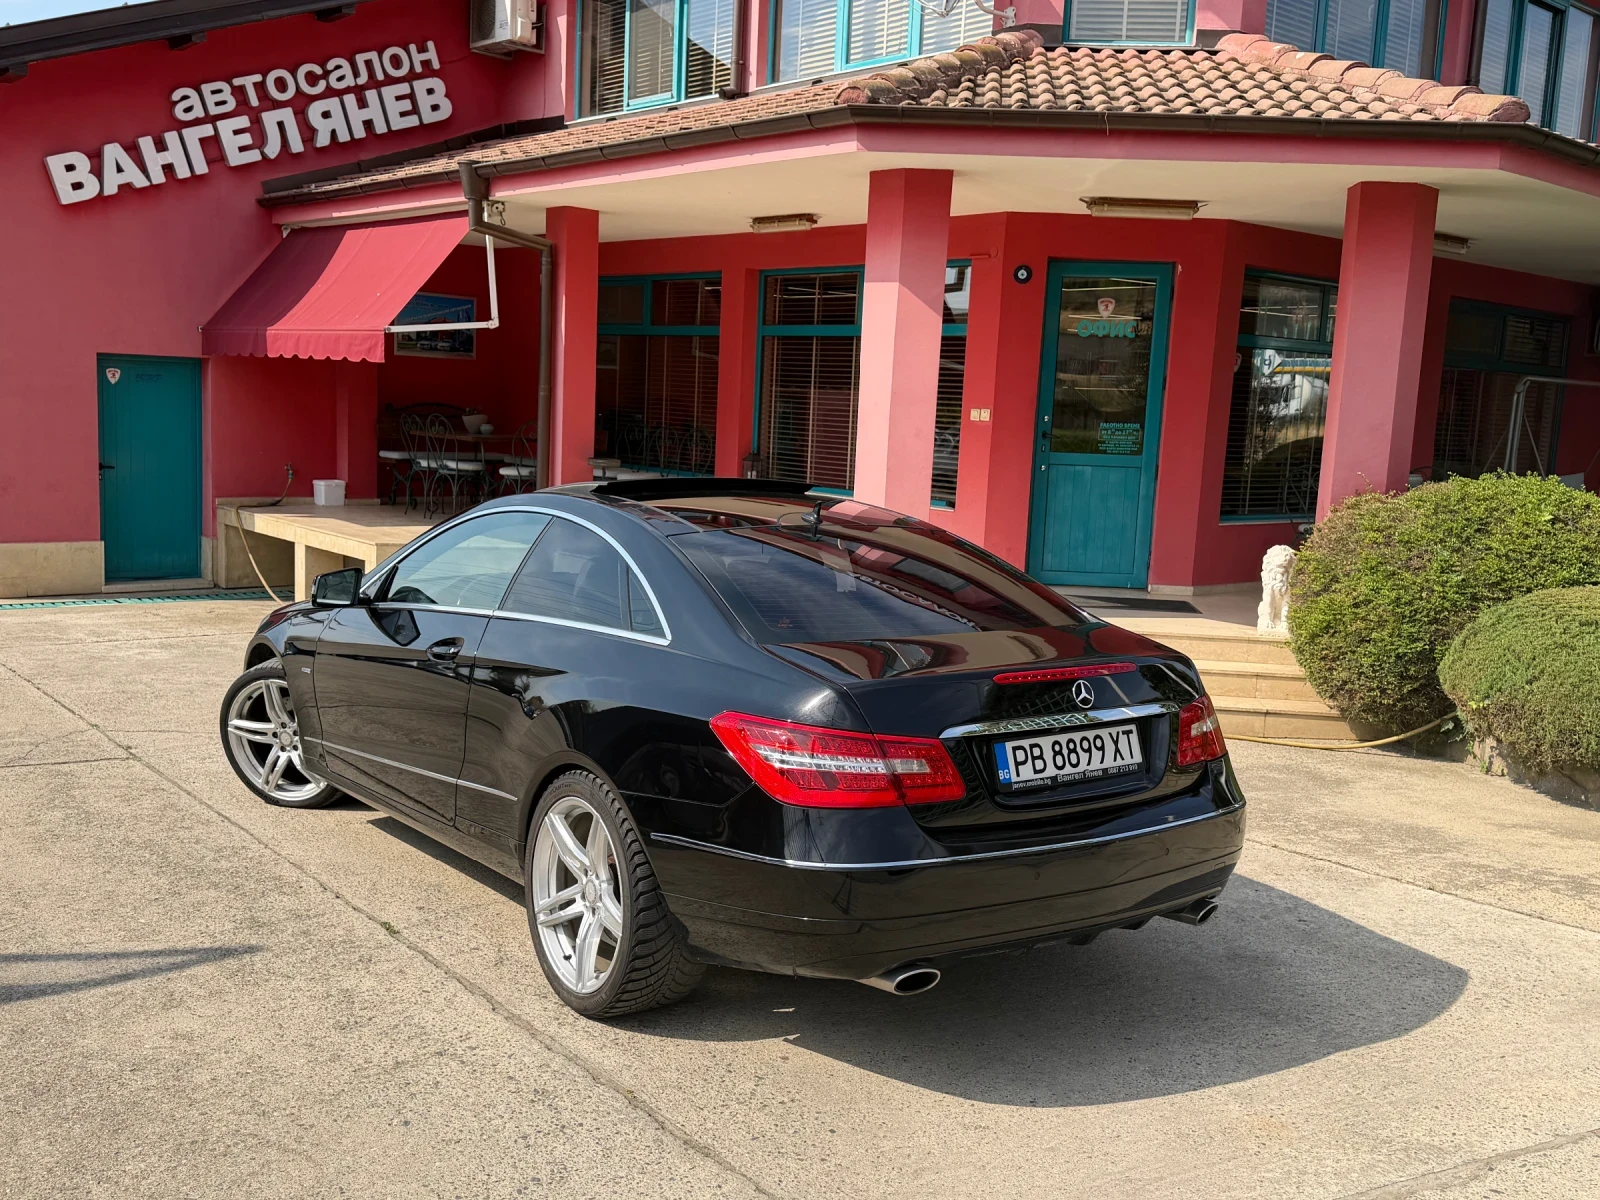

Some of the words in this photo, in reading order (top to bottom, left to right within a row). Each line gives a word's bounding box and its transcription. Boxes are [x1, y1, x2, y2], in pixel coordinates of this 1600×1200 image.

[170, 40, 441, 122] автосалон
[44, 106, 305, 206] ВАНГЕЛ
[306, 76, 453, 148] ЯНЕВ
[1077, 320, 1137, 338] ОФИС
[1012, 743, 1047, 778] PB
[1051, 734, 1105, 771] 8899
[1108, 729, 1134, 763] XT
[998, 769, 1010, 780] BG
[1057, 773, 1084, 782] Вангел
[1085, 769, 1103, 778] Янев
